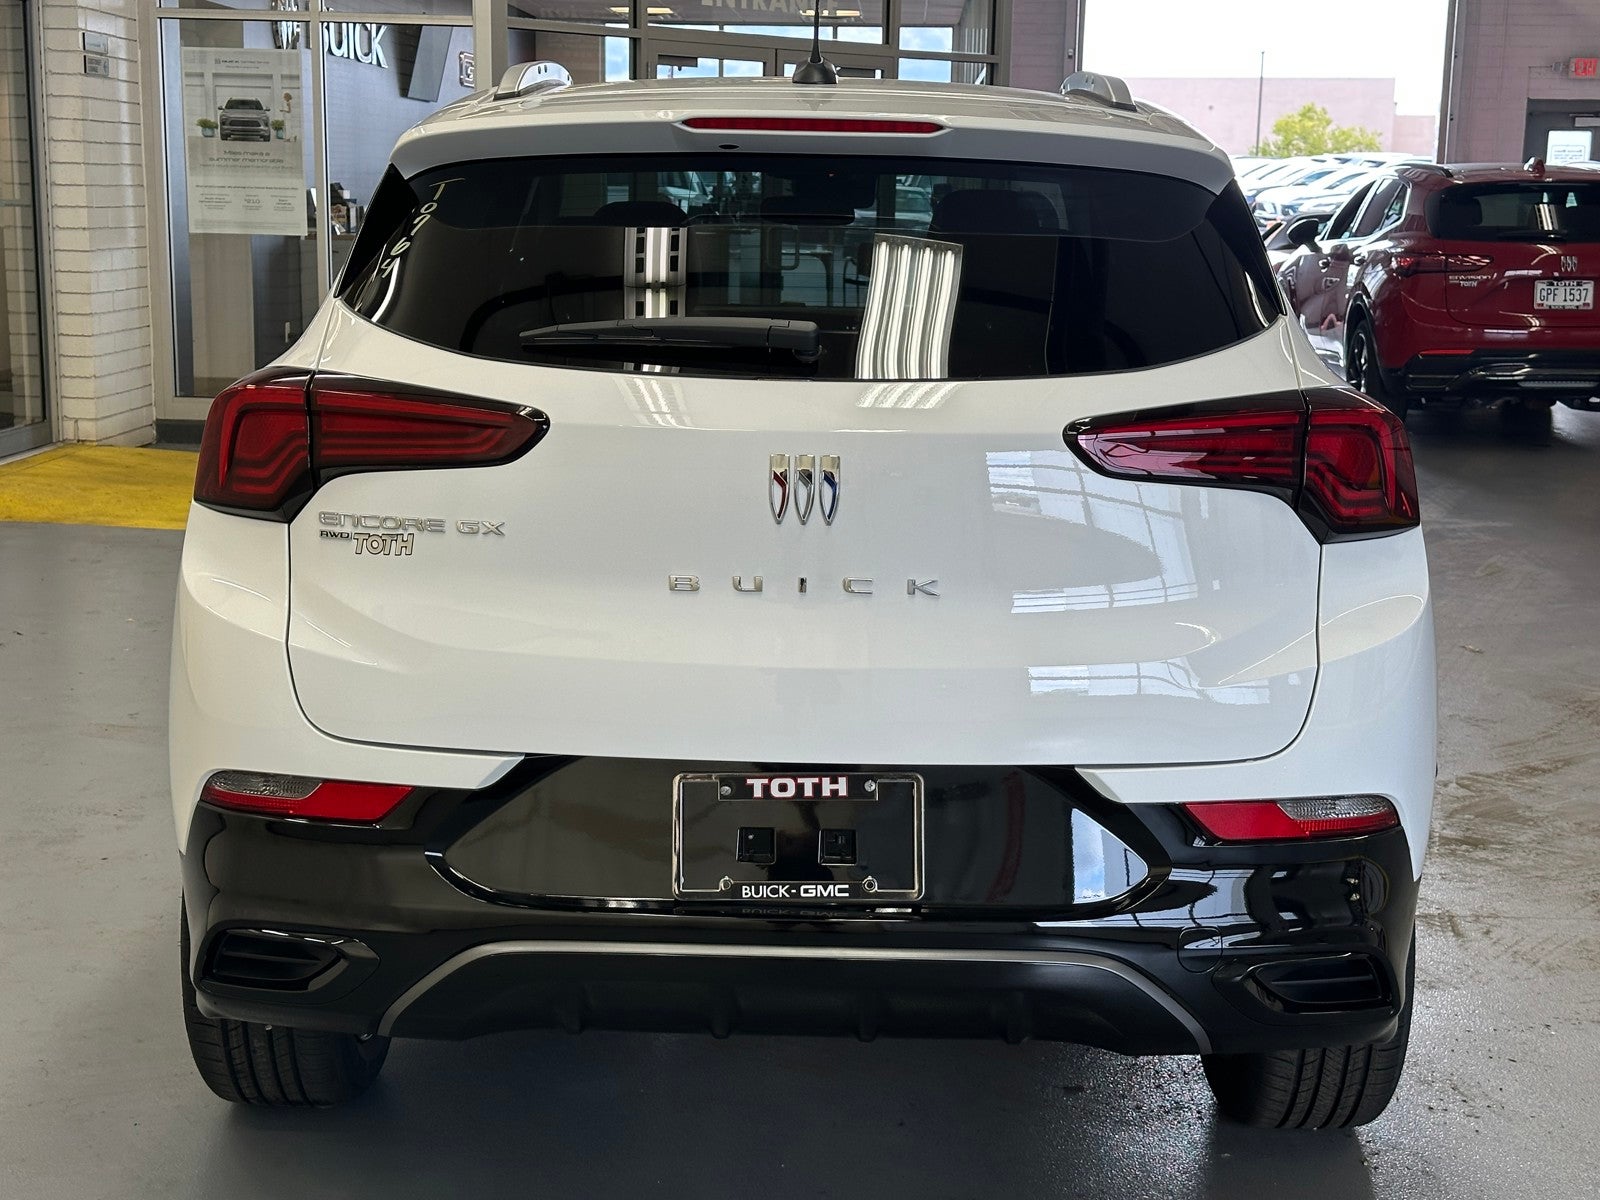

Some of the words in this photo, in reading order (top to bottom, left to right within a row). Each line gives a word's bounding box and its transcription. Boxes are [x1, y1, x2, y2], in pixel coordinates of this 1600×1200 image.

[1539, 288, 1559, 302] GPF
[1563, 288, 1589, 302] 1537
[320, 530, 349, 539] AWD
[456, 519, 506, 536] GX
[353, 532, 415, 556] TOTH
[668, 574, 941, 597] BUICK
[746, 776, 848, 798] TOTH
